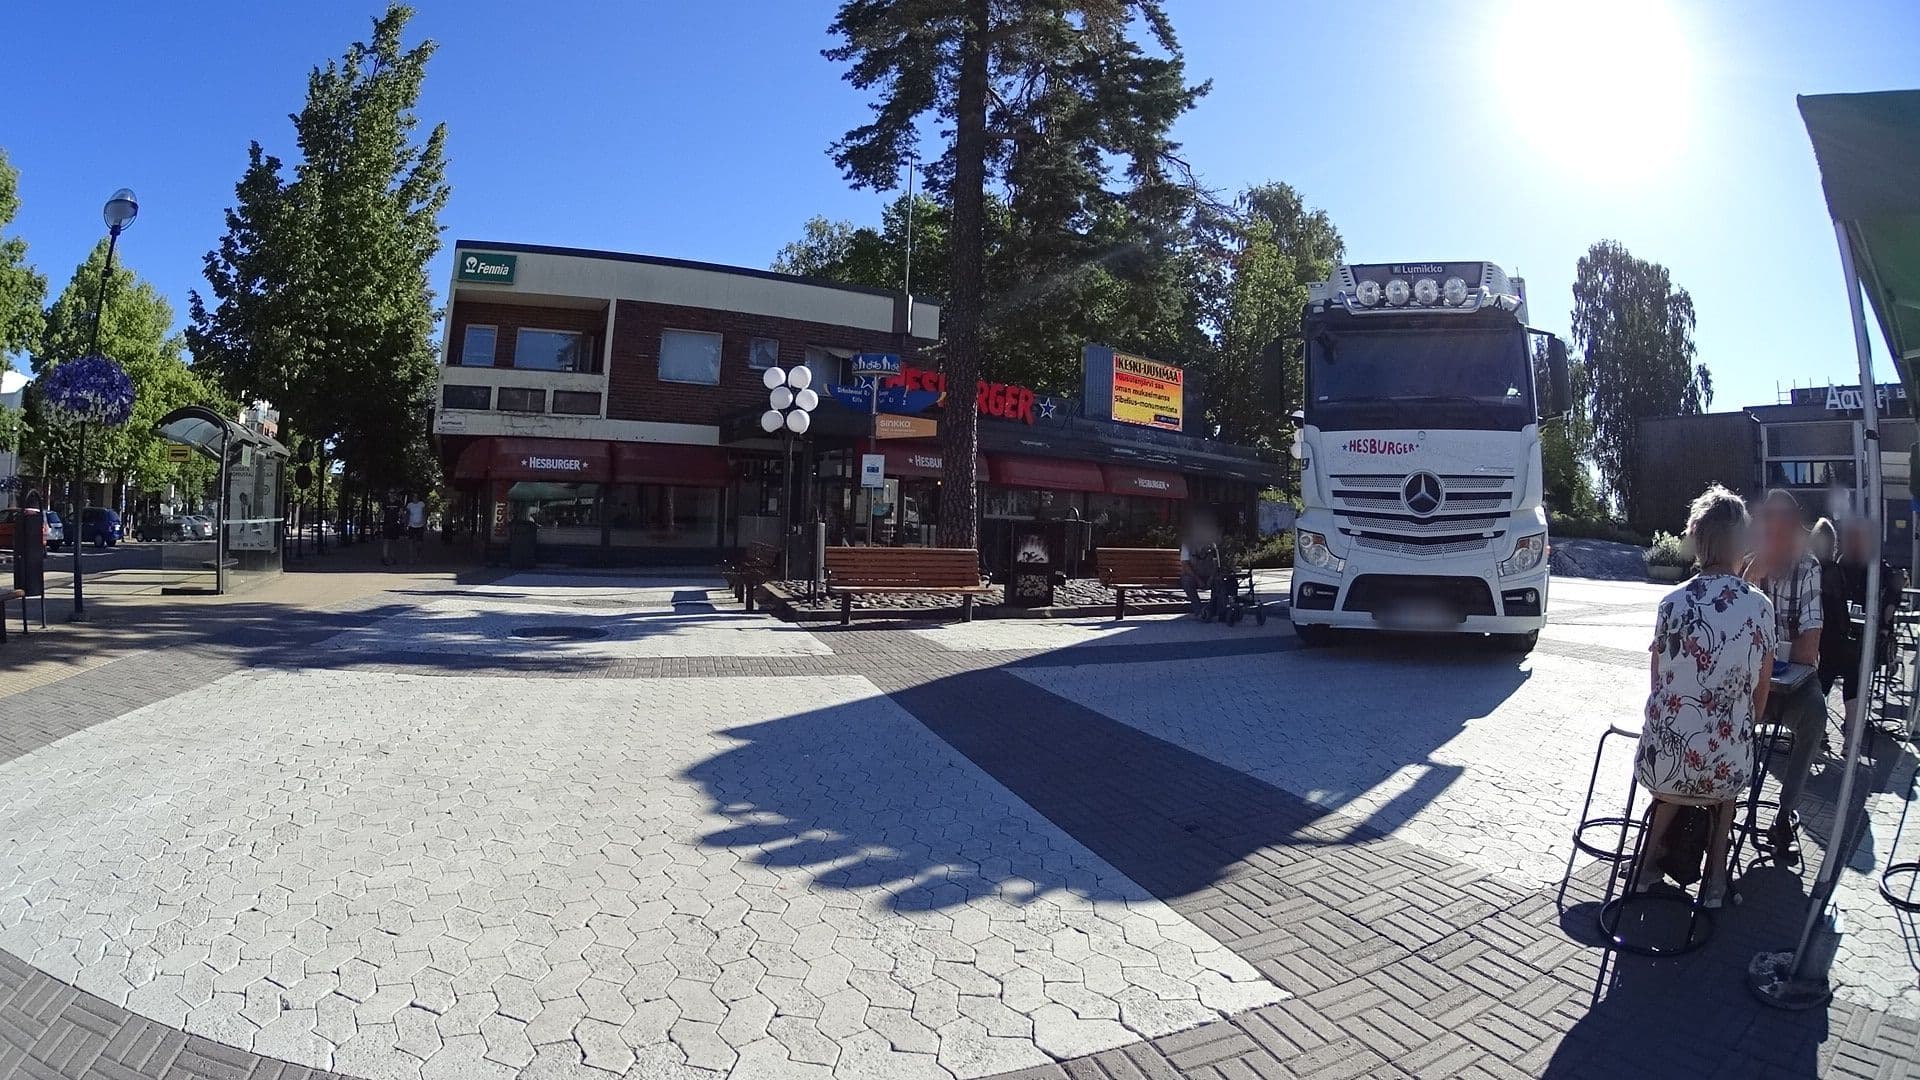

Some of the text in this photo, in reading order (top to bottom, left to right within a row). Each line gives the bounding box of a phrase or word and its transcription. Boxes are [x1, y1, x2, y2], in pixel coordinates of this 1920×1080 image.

[477, 262, 509, 275] Fennia
[1402, 264, 1443, 273] Lumikko
[1119, 357, 1179, 382] KESKI-UUSIMAA
[1349, 438, 1415, 455] HESBURGER
[529, 457, 580, 470] HESBURGER
